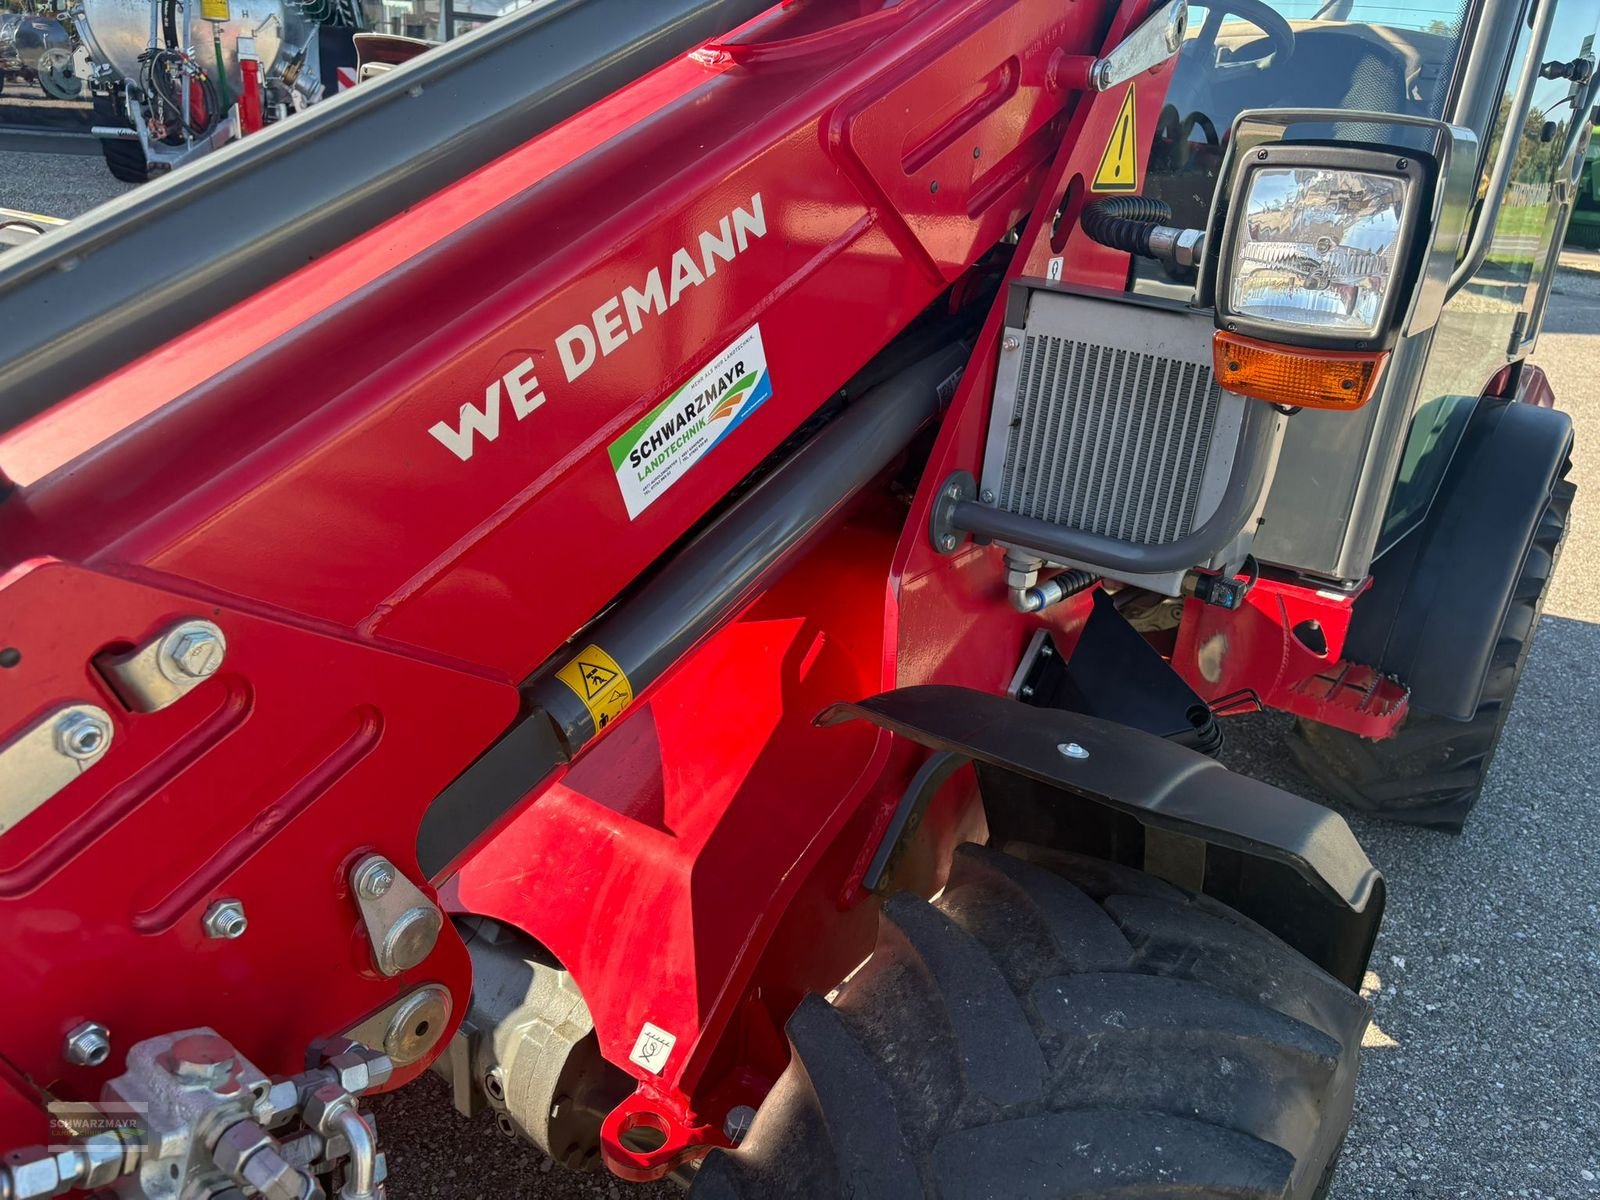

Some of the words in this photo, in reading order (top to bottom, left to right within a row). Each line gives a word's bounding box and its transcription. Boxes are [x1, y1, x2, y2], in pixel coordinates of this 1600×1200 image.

[428, 357, 546, 462] WE
[555, 192, 767, 383] DEMANN
[629, 361, 746, 469] SCHWARZMAYR
[637, 417, 708, 482] LANDTECHNIK
